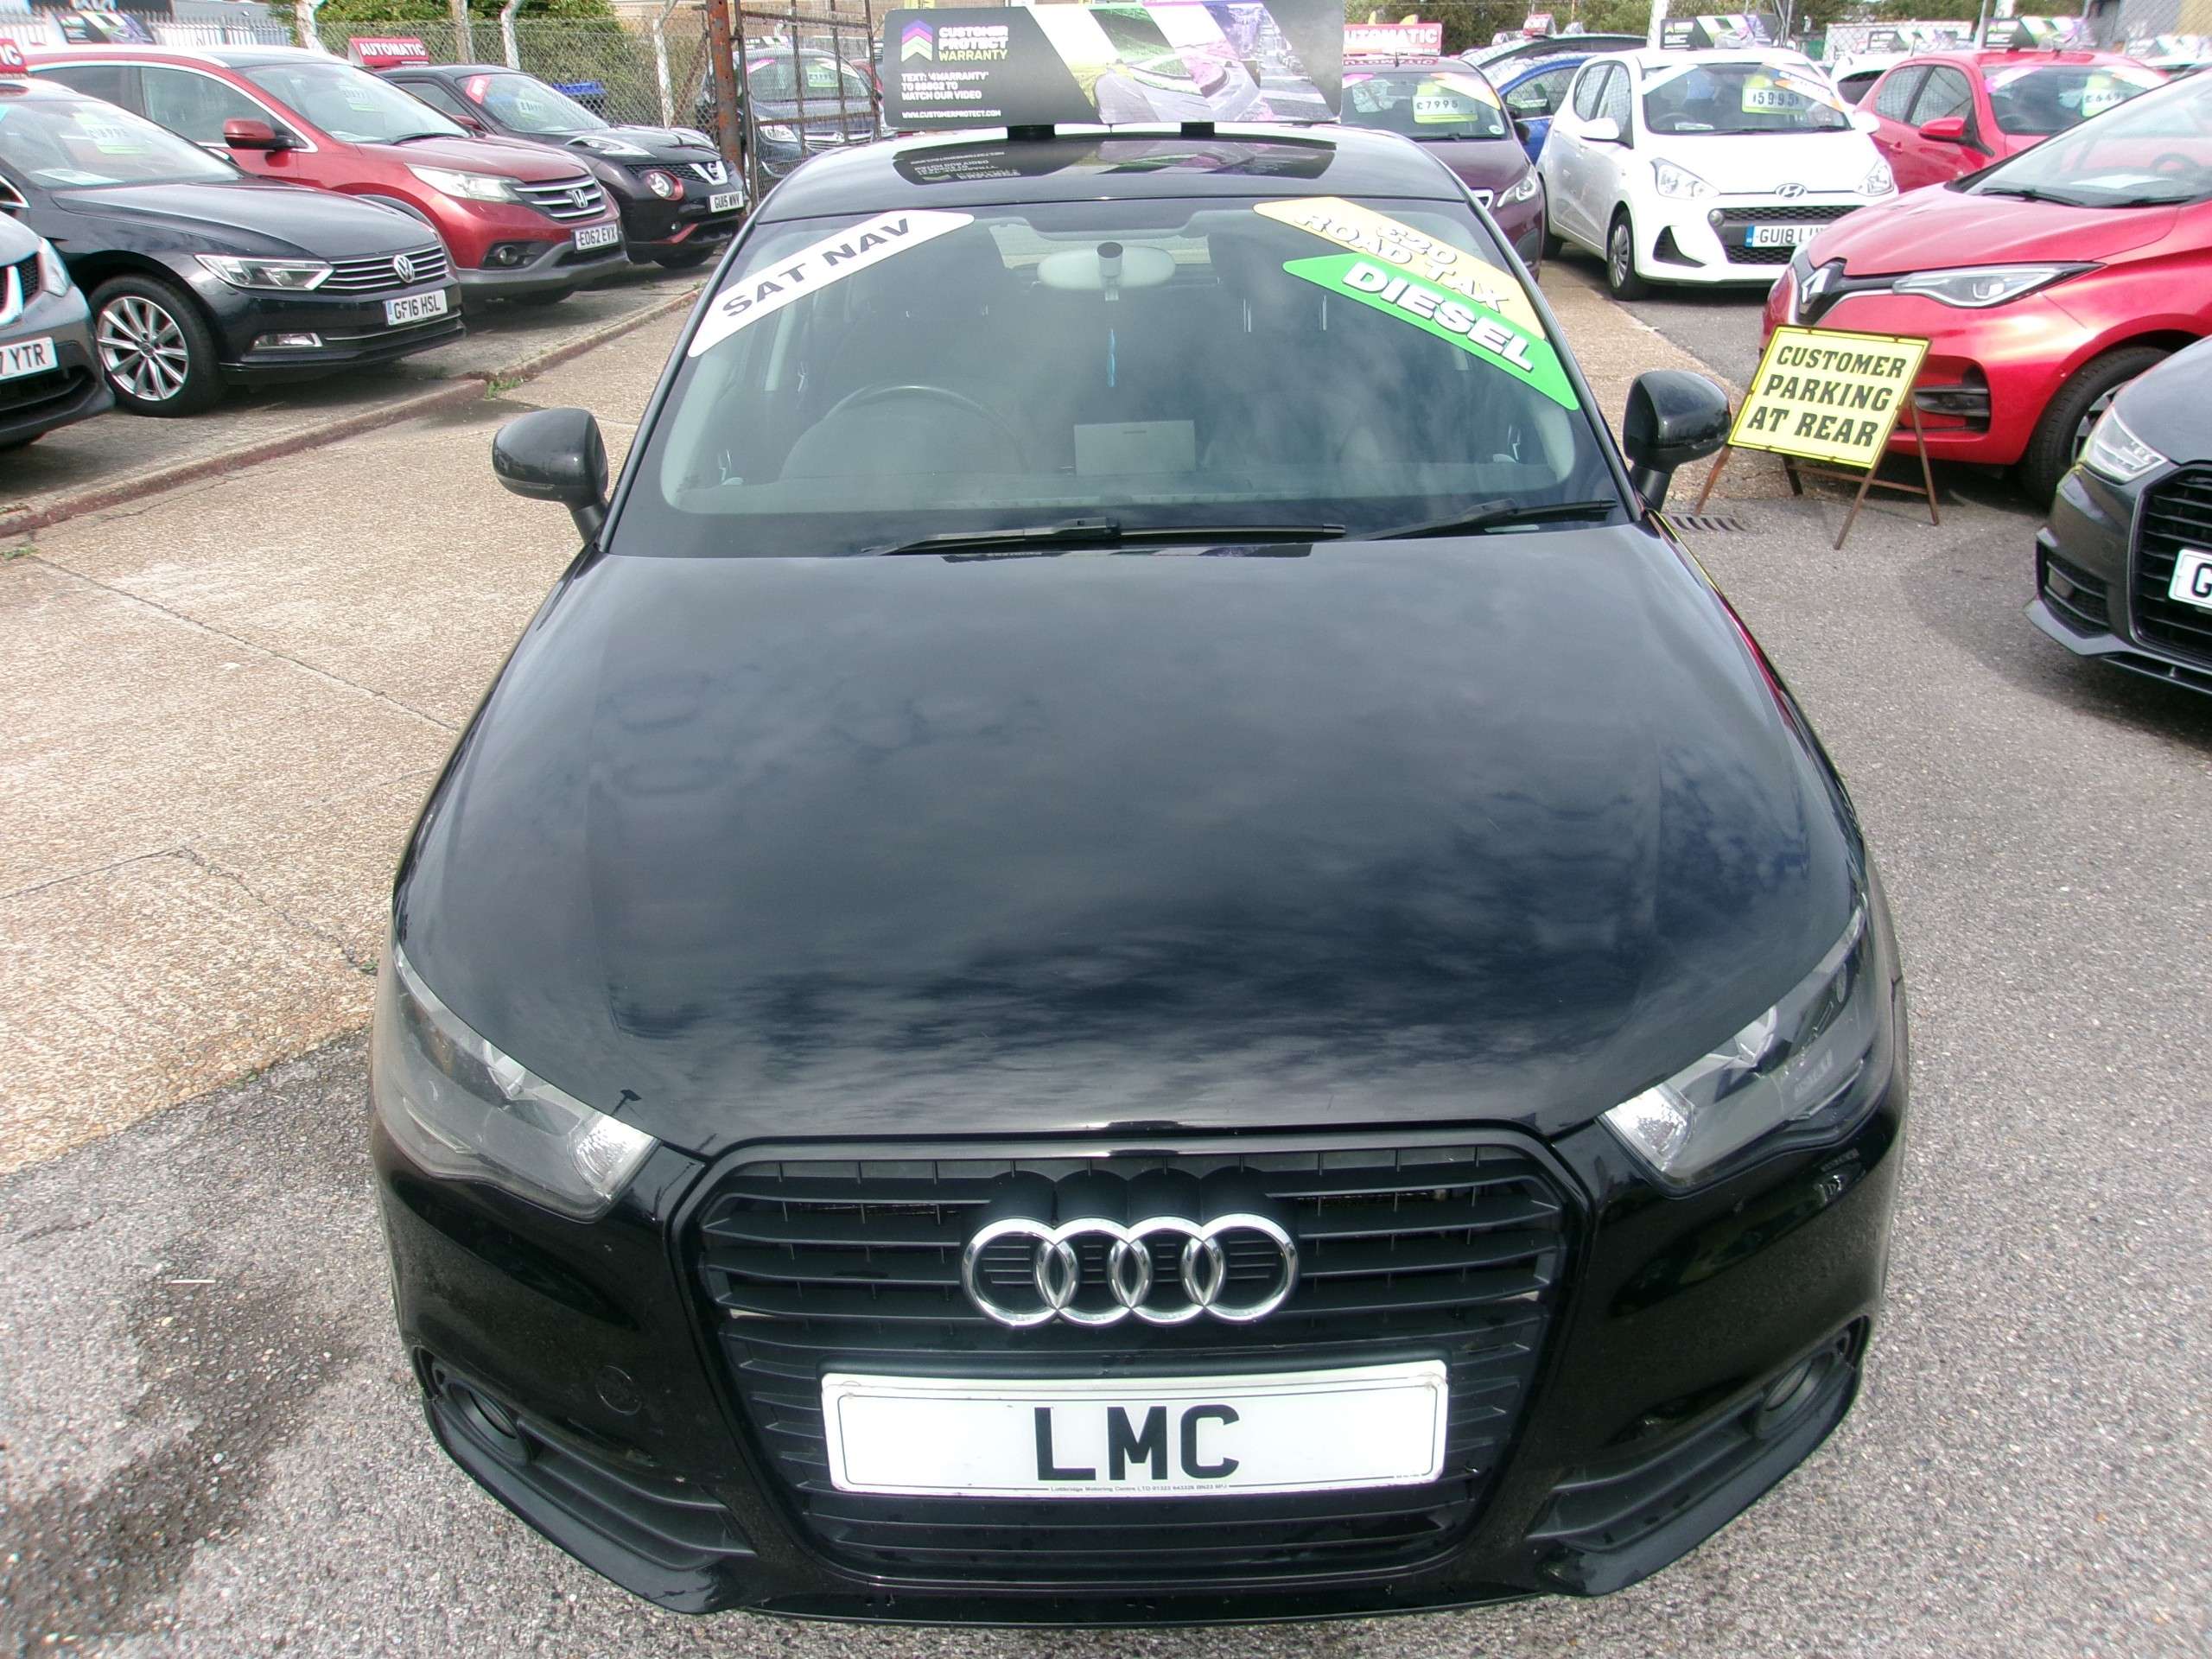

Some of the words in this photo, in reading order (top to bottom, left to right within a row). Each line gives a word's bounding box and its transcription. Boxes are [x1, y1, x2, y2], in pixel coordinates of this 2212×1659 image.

[938, 26, 1009, 38] CUSTOMER
[1344, 29, 1439, 44] UTOMATIC
[359, 42, 426, 57] AUTOMATIC
[938, 37, 1009, 50] PROTECT
[939, 49, 1008, 61] WARRANTY
[901, 82, 914, 91] TO
[946, 81, 958, 90] TO
[901, 91, 933, 100] WATCH
[934, 91, 953, 99] OUR
[953, 90, 982, 99] VIDEO
[1415, 99, 1459, 110] £7995
[1759, 228, 1795, 244] GU18
[722, 263, 806, 317] SAT
[822, 219, 910, 267] NAV
[1425, 262, 1509, 314] TAX
[420, 295, 442, 315] HSL
[1341, 261, 1535, 373] DIESEL
[9, 343, 46, 371] YTR
[1777, 346, 1906, 378] CUSTOMER
[1763, 374, 1892, 411] PARKING
[1747, 406, 1789, 432] AT
[1794, 412, 1878, 447] REAR
[1034, 1404, 1240, 1481] LMC
